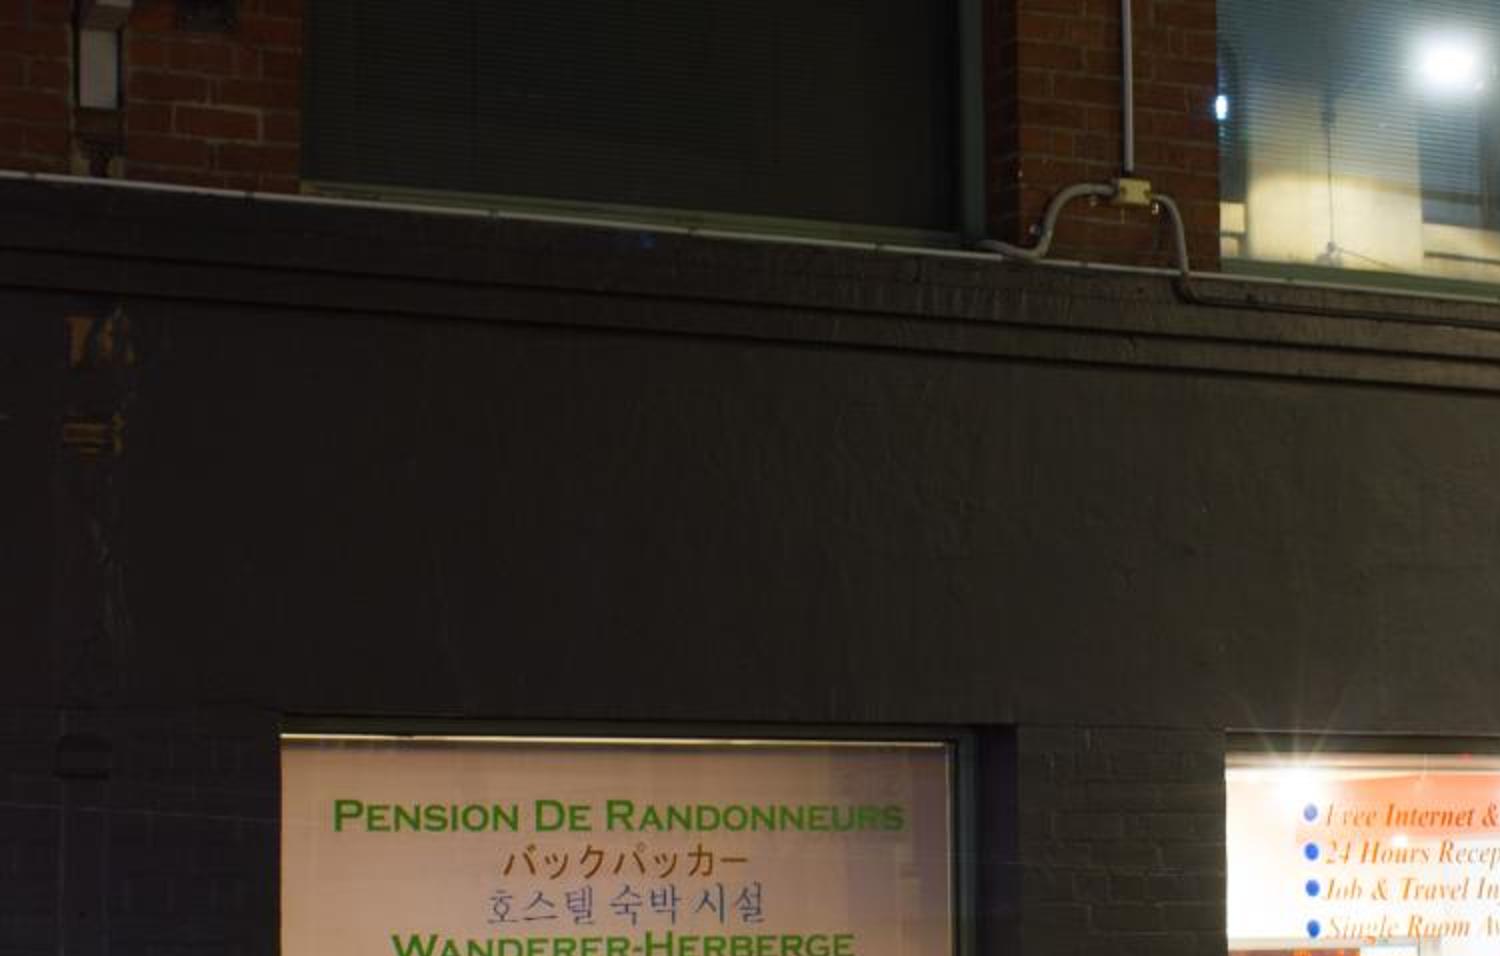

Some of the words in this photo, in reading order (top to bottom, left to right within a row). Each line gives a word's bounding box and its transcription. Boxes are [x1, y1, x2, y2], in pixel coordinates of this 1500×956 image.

[333, 799, 519, 833] PENSION
[535, 799, 593, 833] DE
[605, 799, 906, 833] RANDONNEURS
[1385, 803, 1475, 827] Internet
[1481, 803, 1499, 828] &
[503, 842, 749, 880] バックパッカー
[1325, 840, 1351, 865] 24
[1359, 841, 1431, 865] Hours
[487, 886, 595, 926] 호스텔
[609, 884, 681, 926] 숙박
[694, 880, 766, 925] 시설
[1323, 877, 1362, 901] Job
[1371, 879, 1389, 901] &
[1401, 876, 1470, 900] Travel
[1325, 916, 1398, 945] Single
[1408, 914, 1472, 939] Room
